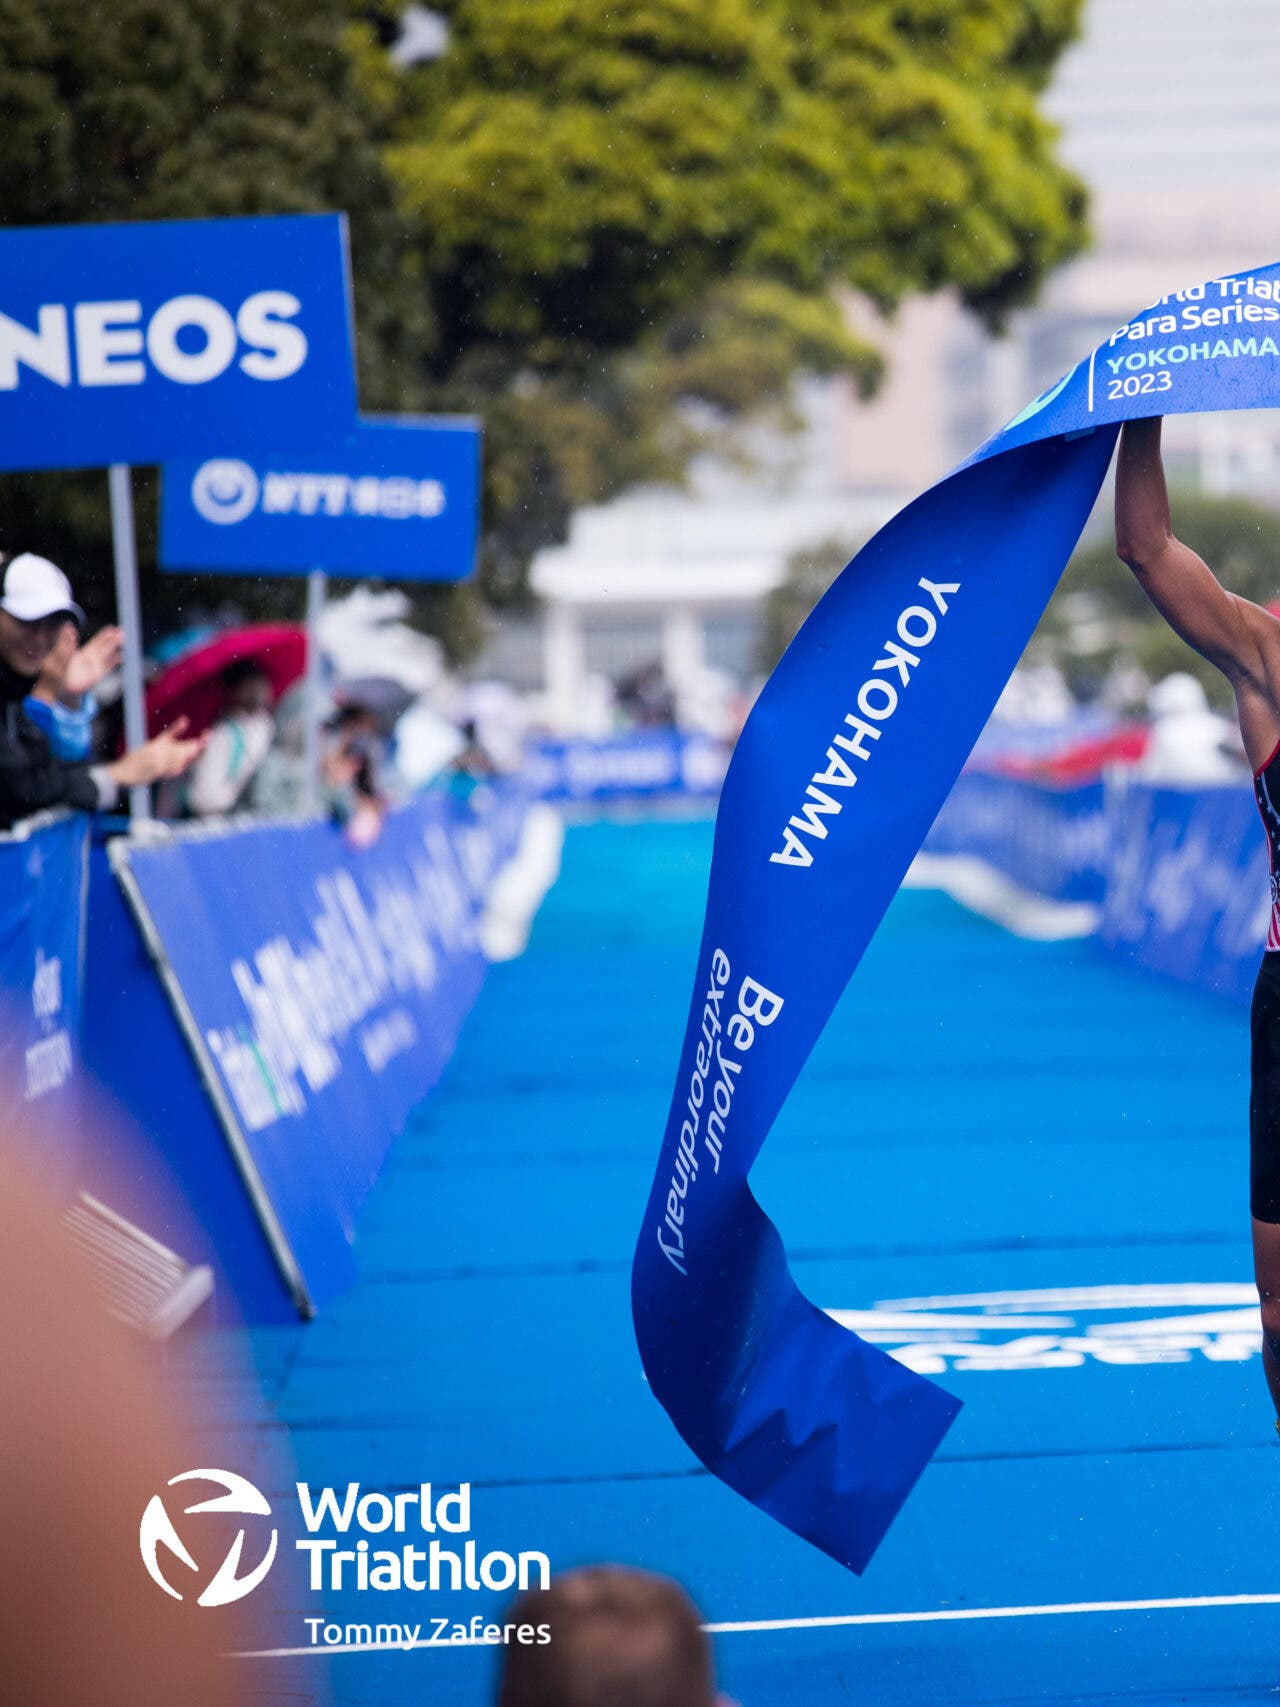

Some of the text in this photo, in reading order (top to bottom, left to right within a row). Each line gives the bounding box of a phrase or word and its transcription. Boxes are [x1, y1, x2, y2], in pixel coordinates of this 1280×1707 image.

[1107, 337, 1280, 375] YOKOHAMA
[1108, 370, 1172, 400] 2023
[1109, 299, 1280, 347] Para Series
[769, 577, 961, 868] YOKOHAMA
[657, 948, 731, 1276] extraordinary
[705, 975, 785, 1175] Be your
